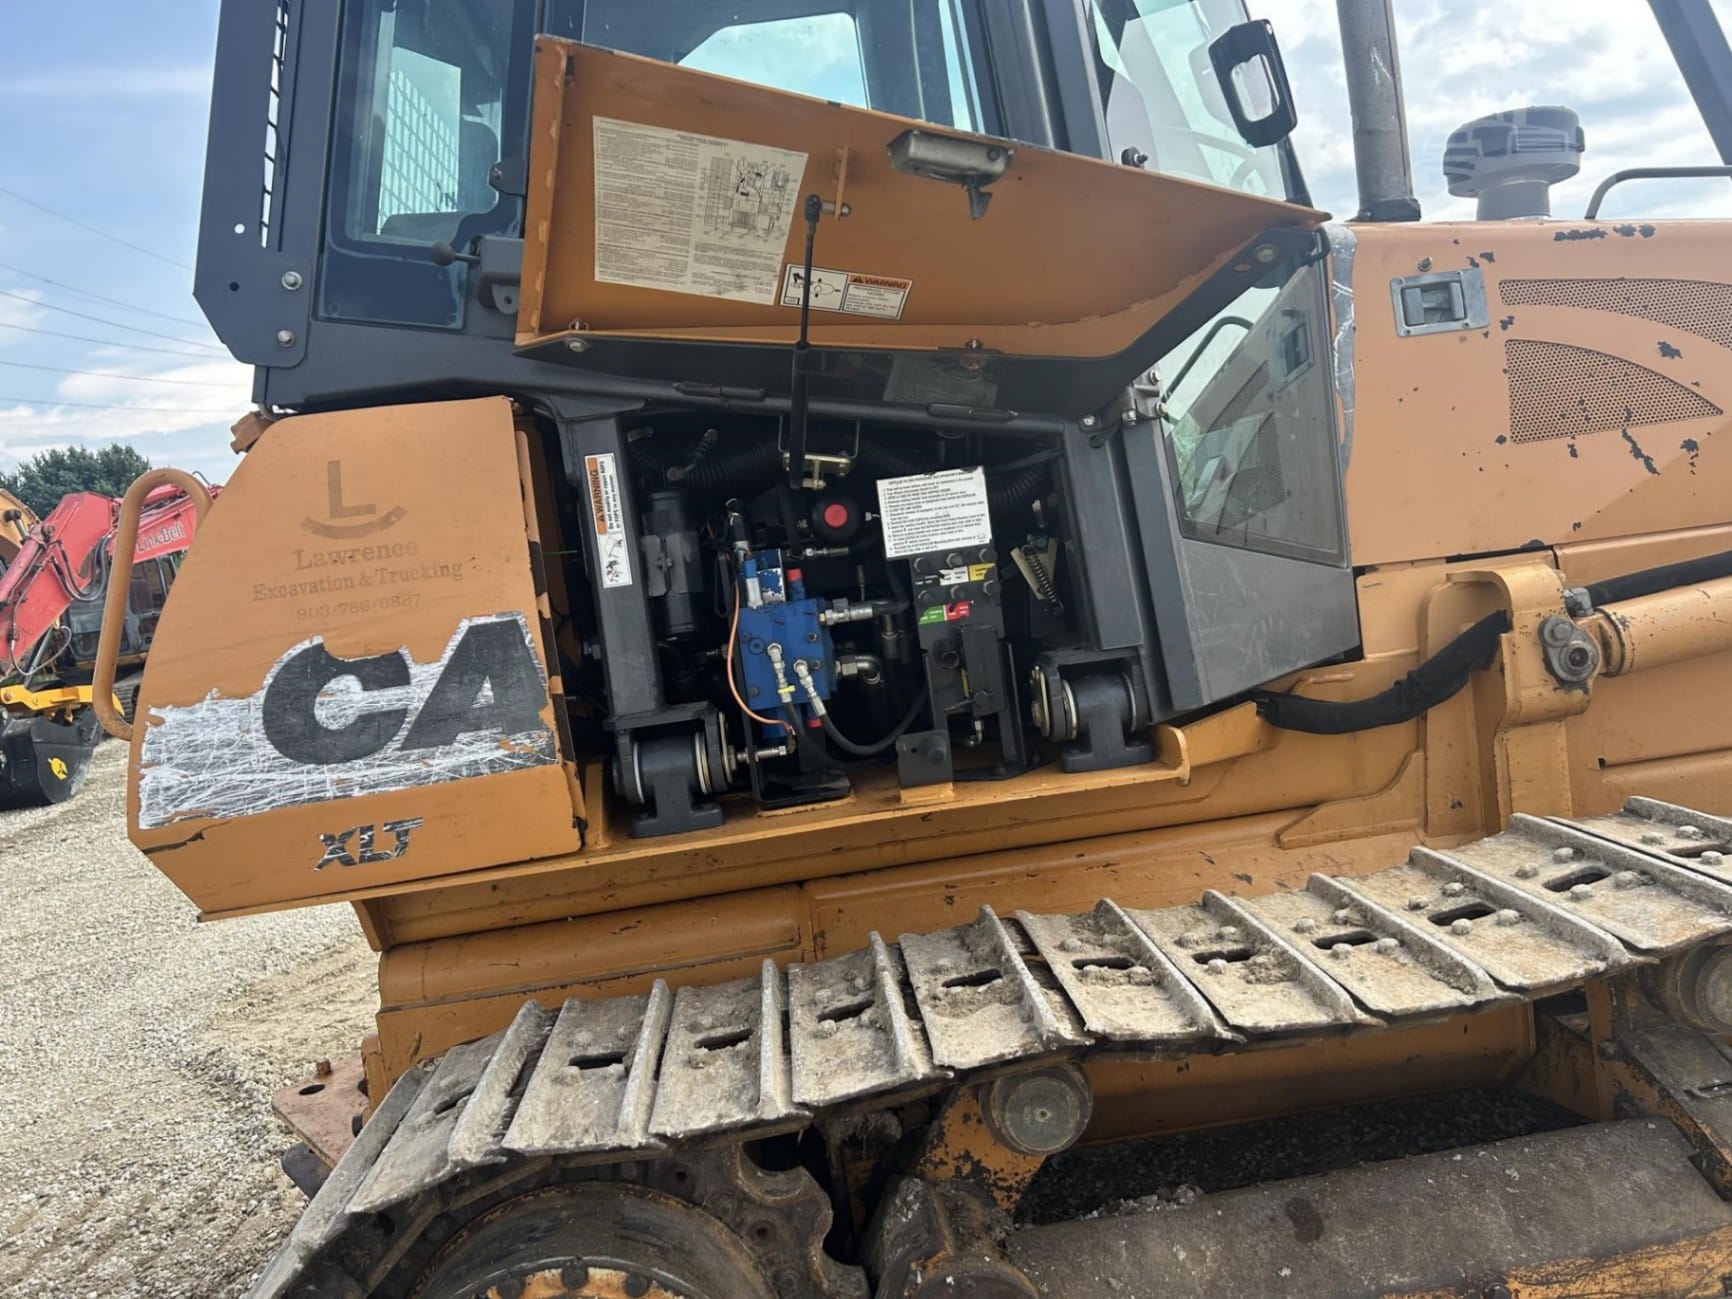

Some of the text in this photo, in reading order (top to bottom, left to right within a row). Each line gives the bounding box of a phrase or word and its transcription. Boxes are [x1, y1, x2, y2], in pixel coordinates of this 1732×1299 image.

[865, 277, 907, 290] WARNING
[590, 469, 604, 513] WARNING
[294, 541, 417, 571] Lawrence
[252, 560, 463, 602] Excavation & Trucking
[262, 616, 548, 765] CA
[313, 817, 424, 872] XLT
